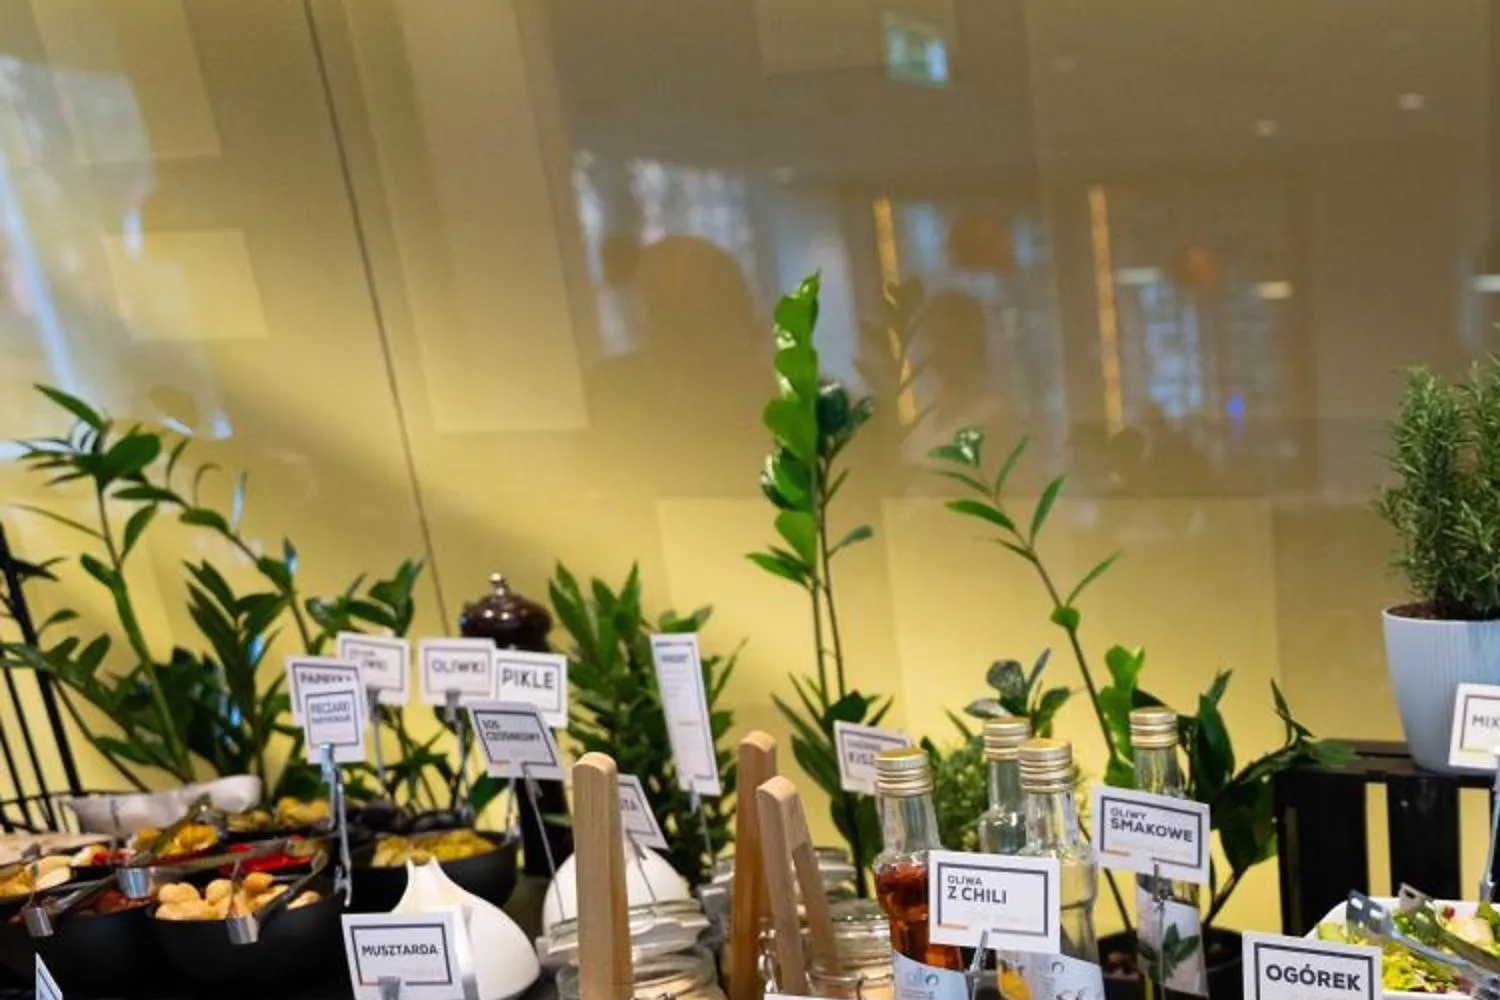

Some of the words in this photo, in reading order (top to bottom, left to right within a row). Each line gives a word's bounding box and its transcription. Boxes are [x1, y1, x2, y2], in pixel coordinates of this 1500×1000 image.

[432, 658, 486, 673] OLIWKI
[502, 667, 554, 689] PIKLE
[1472, 714, 1500, 727] MIX
[1110, 807, 1147, 819] OLIWY
[1110, 817, 1193, 842] SMAKOWE
[947, 875, 983, 885] OLIWA
[947, 886, 957, 900] Z
[961, 887, 1007, 904] CHILI
[361, 944, 439, 956] MUSZTARDA
[1266, 964, 1361, 991] OGÓREK
